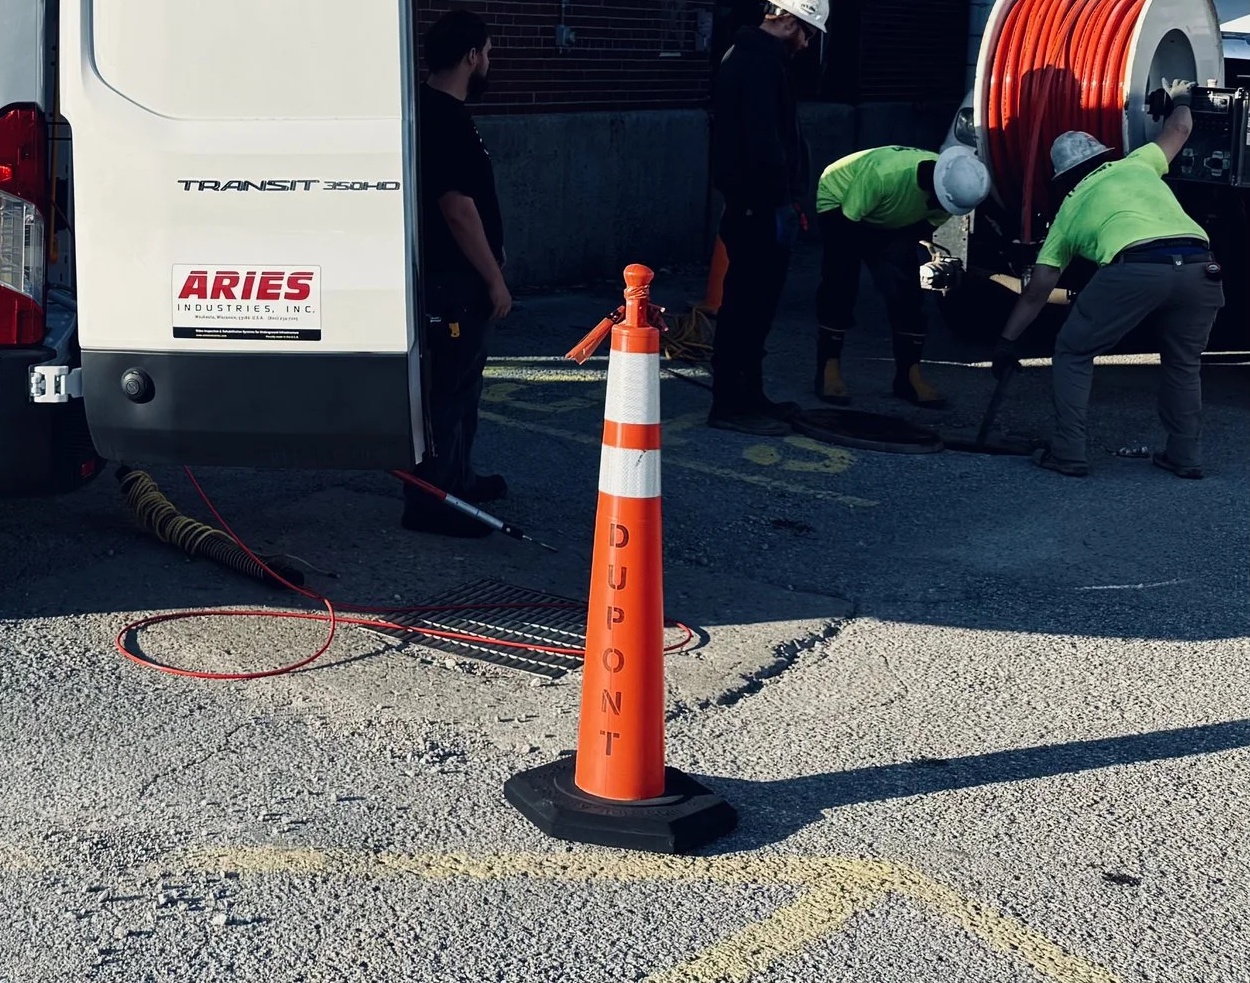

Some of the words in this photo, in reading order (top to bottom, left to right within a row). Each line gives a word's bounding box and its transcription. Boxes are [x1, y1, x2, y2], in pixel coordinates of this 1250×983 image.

[177, 179, 320, 192] TRANSIT
[322, 180, 401, 191] 350HD
[178, 270, 315, 301] ARIES
[177, 303, 275, 314] INDUSTRIES,
[286, 305, 316, 314] INC.
[600, 523, 630, 756] DUPONT
